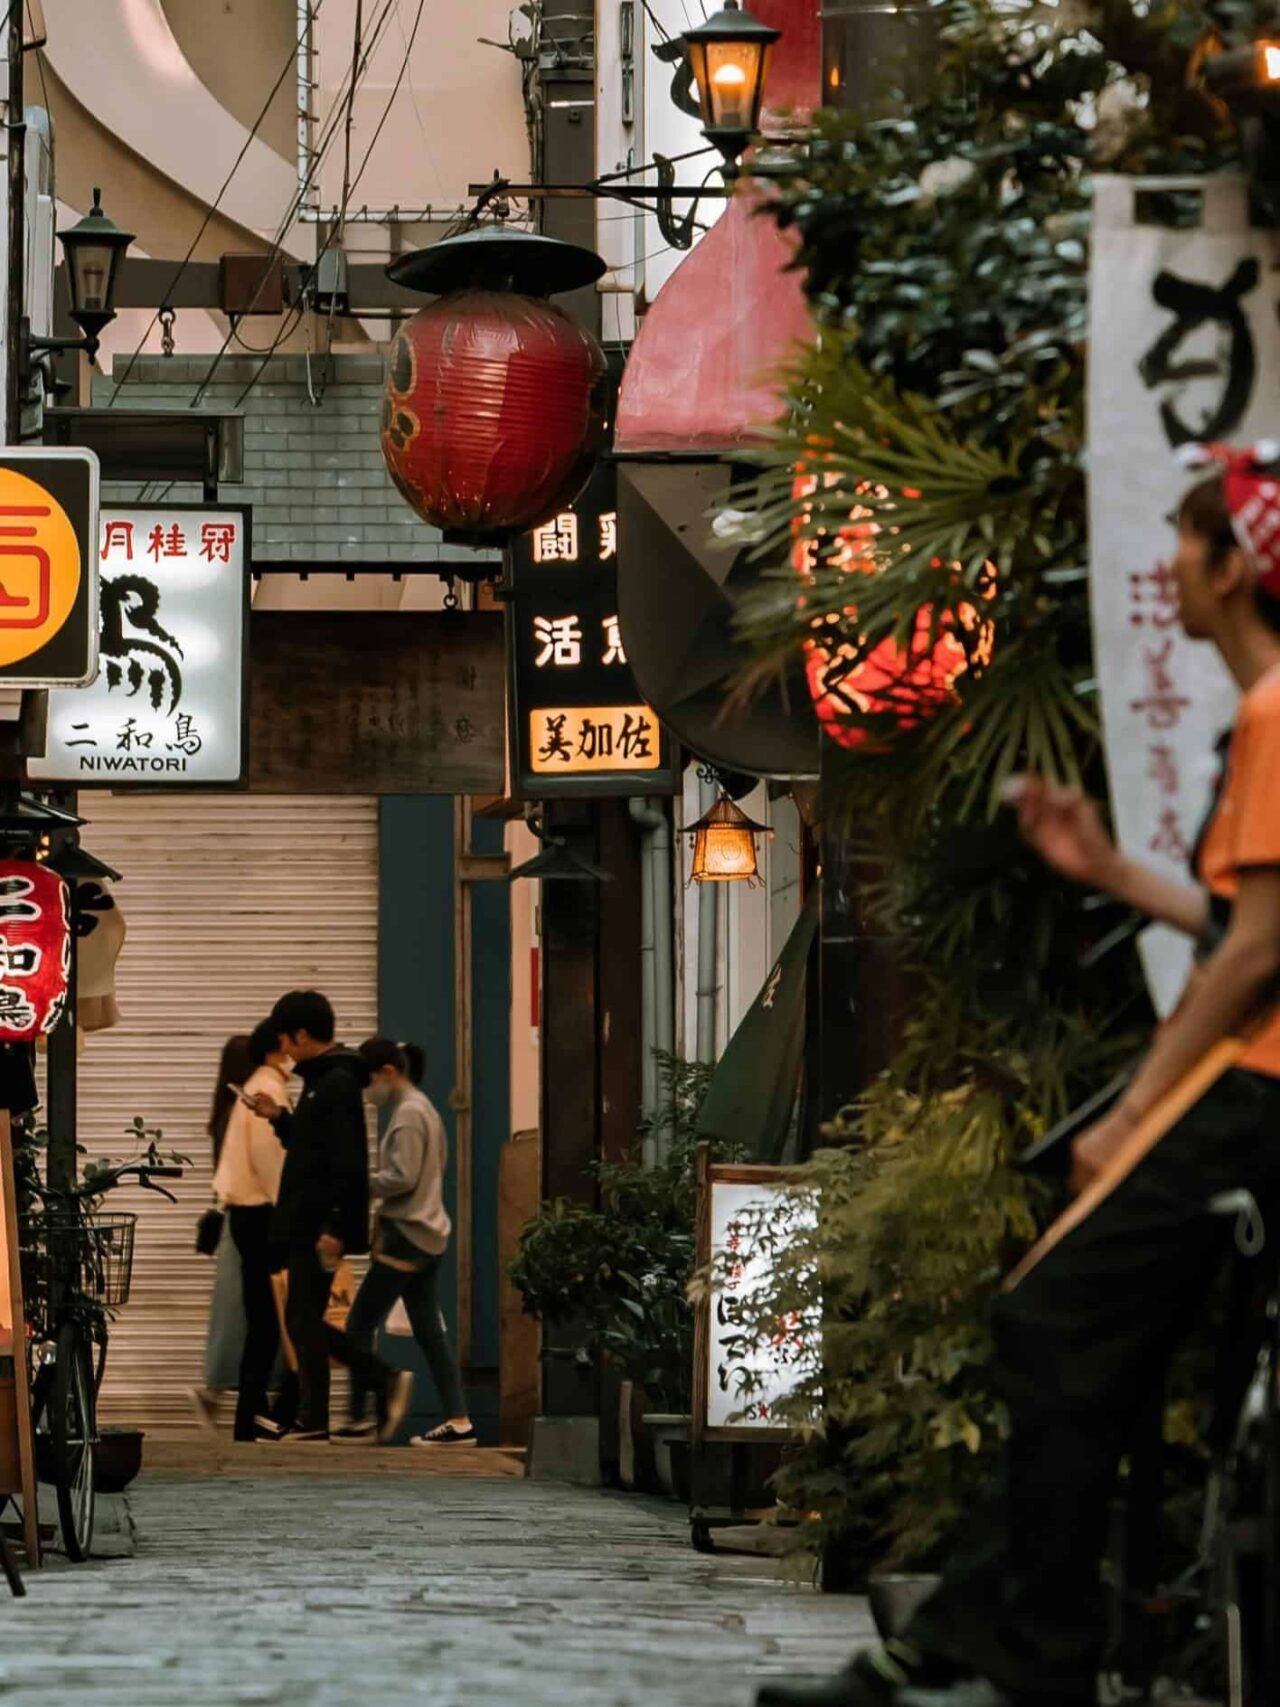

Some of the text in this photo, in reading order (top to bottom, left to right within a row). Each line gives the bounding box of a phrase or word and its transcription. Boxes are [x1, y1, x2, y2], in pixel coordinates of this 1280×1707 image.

[100, 522, 236, 563] 月桂冠
[64, 712, 203, 756] 二和鳥
[538, 712, 654, 763] 美加佐
[79, 756, 187, 772] NIWATORI
